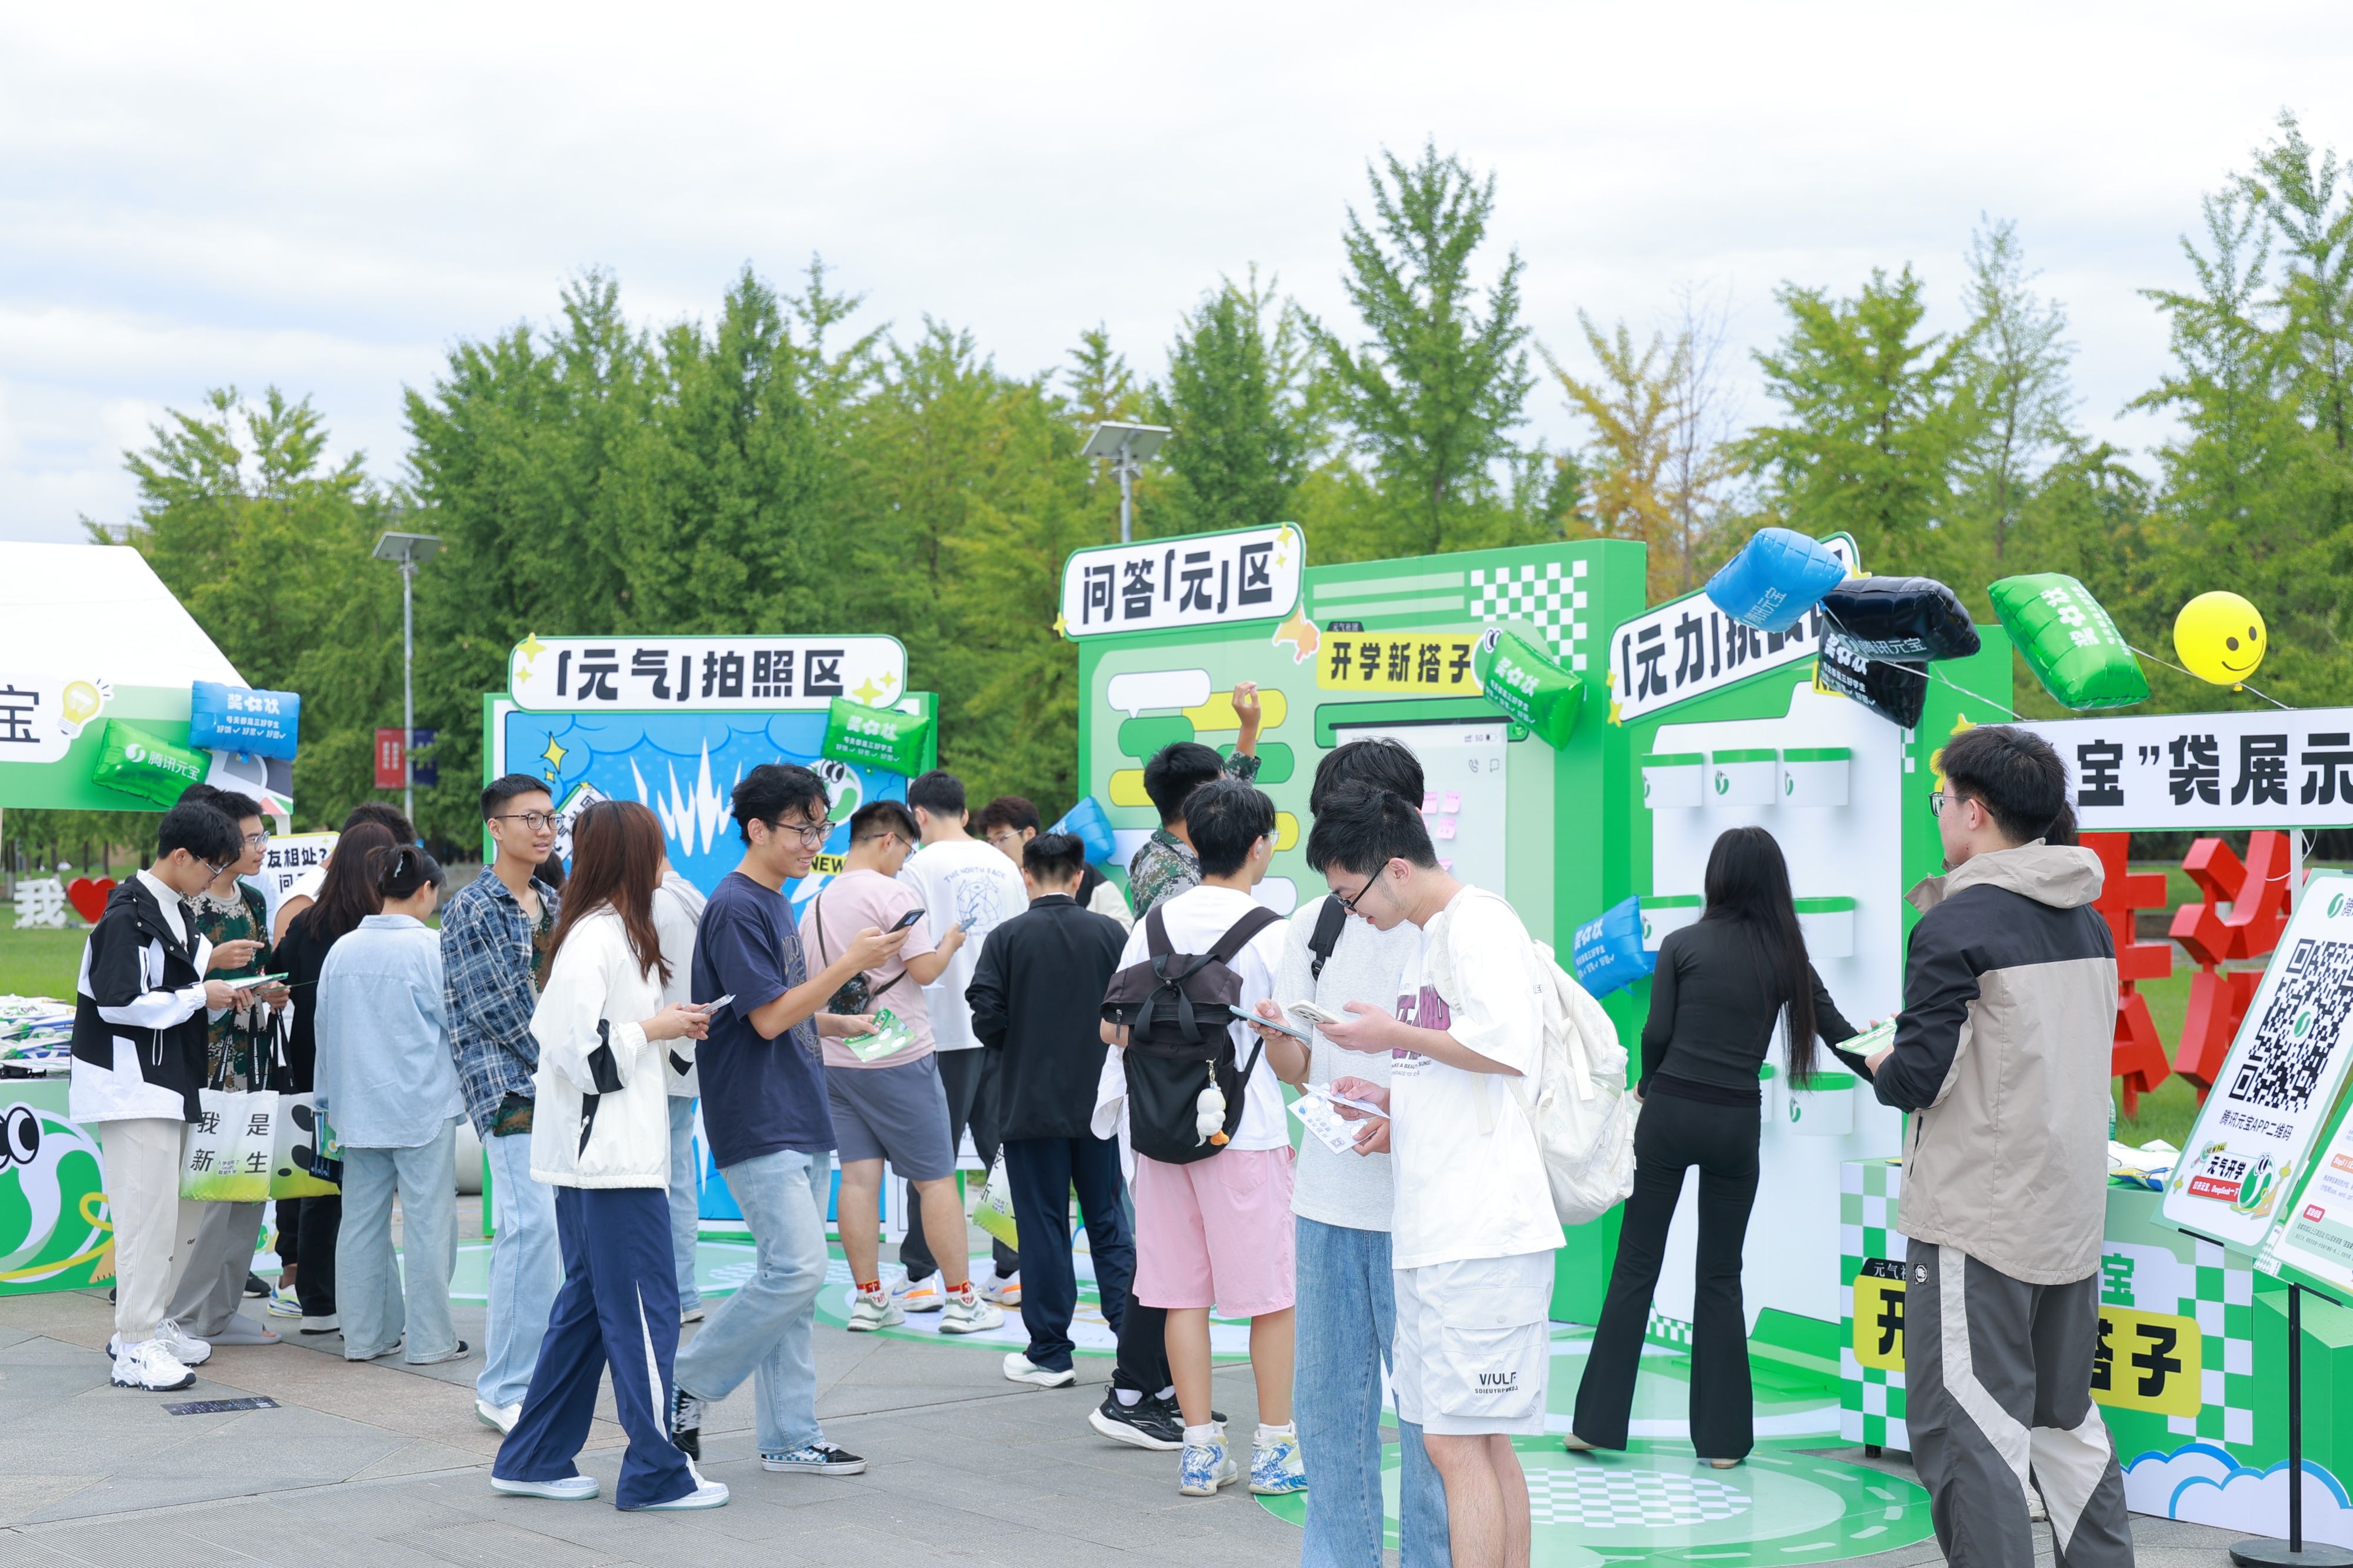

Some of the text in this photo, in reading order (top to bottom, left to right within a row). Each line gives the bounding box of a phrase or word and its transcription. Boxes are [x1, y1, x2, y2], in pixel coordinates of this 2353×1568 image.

[1744, 587, 1787, 625] 腾讯元宝
[1858, 638, 1927, 654] 腾讯元宝
[1331, 642, 1471, 683] 开学新搭子
[1475, 734, 1484, 742] 5G
[148, 750, 201, 781] 腾讯元宝
[279, 873, 305, 893] 问
[944, 870, 960, 883] THE
[987, 868, 1006, 879] FACE
[13, 878, 67, 929] 我
[246, 1113, 270, 1136] 是
[2219, 1109, 2294, 1141] 腾讯元宝APP二维码
[190, 1149, 215, 1172] 新
[244, 1151, 268, 1174] 生
[2207, 1156, 2247, 1180] 元气开学
[2101, 1253, 2135, 1307] 宝
